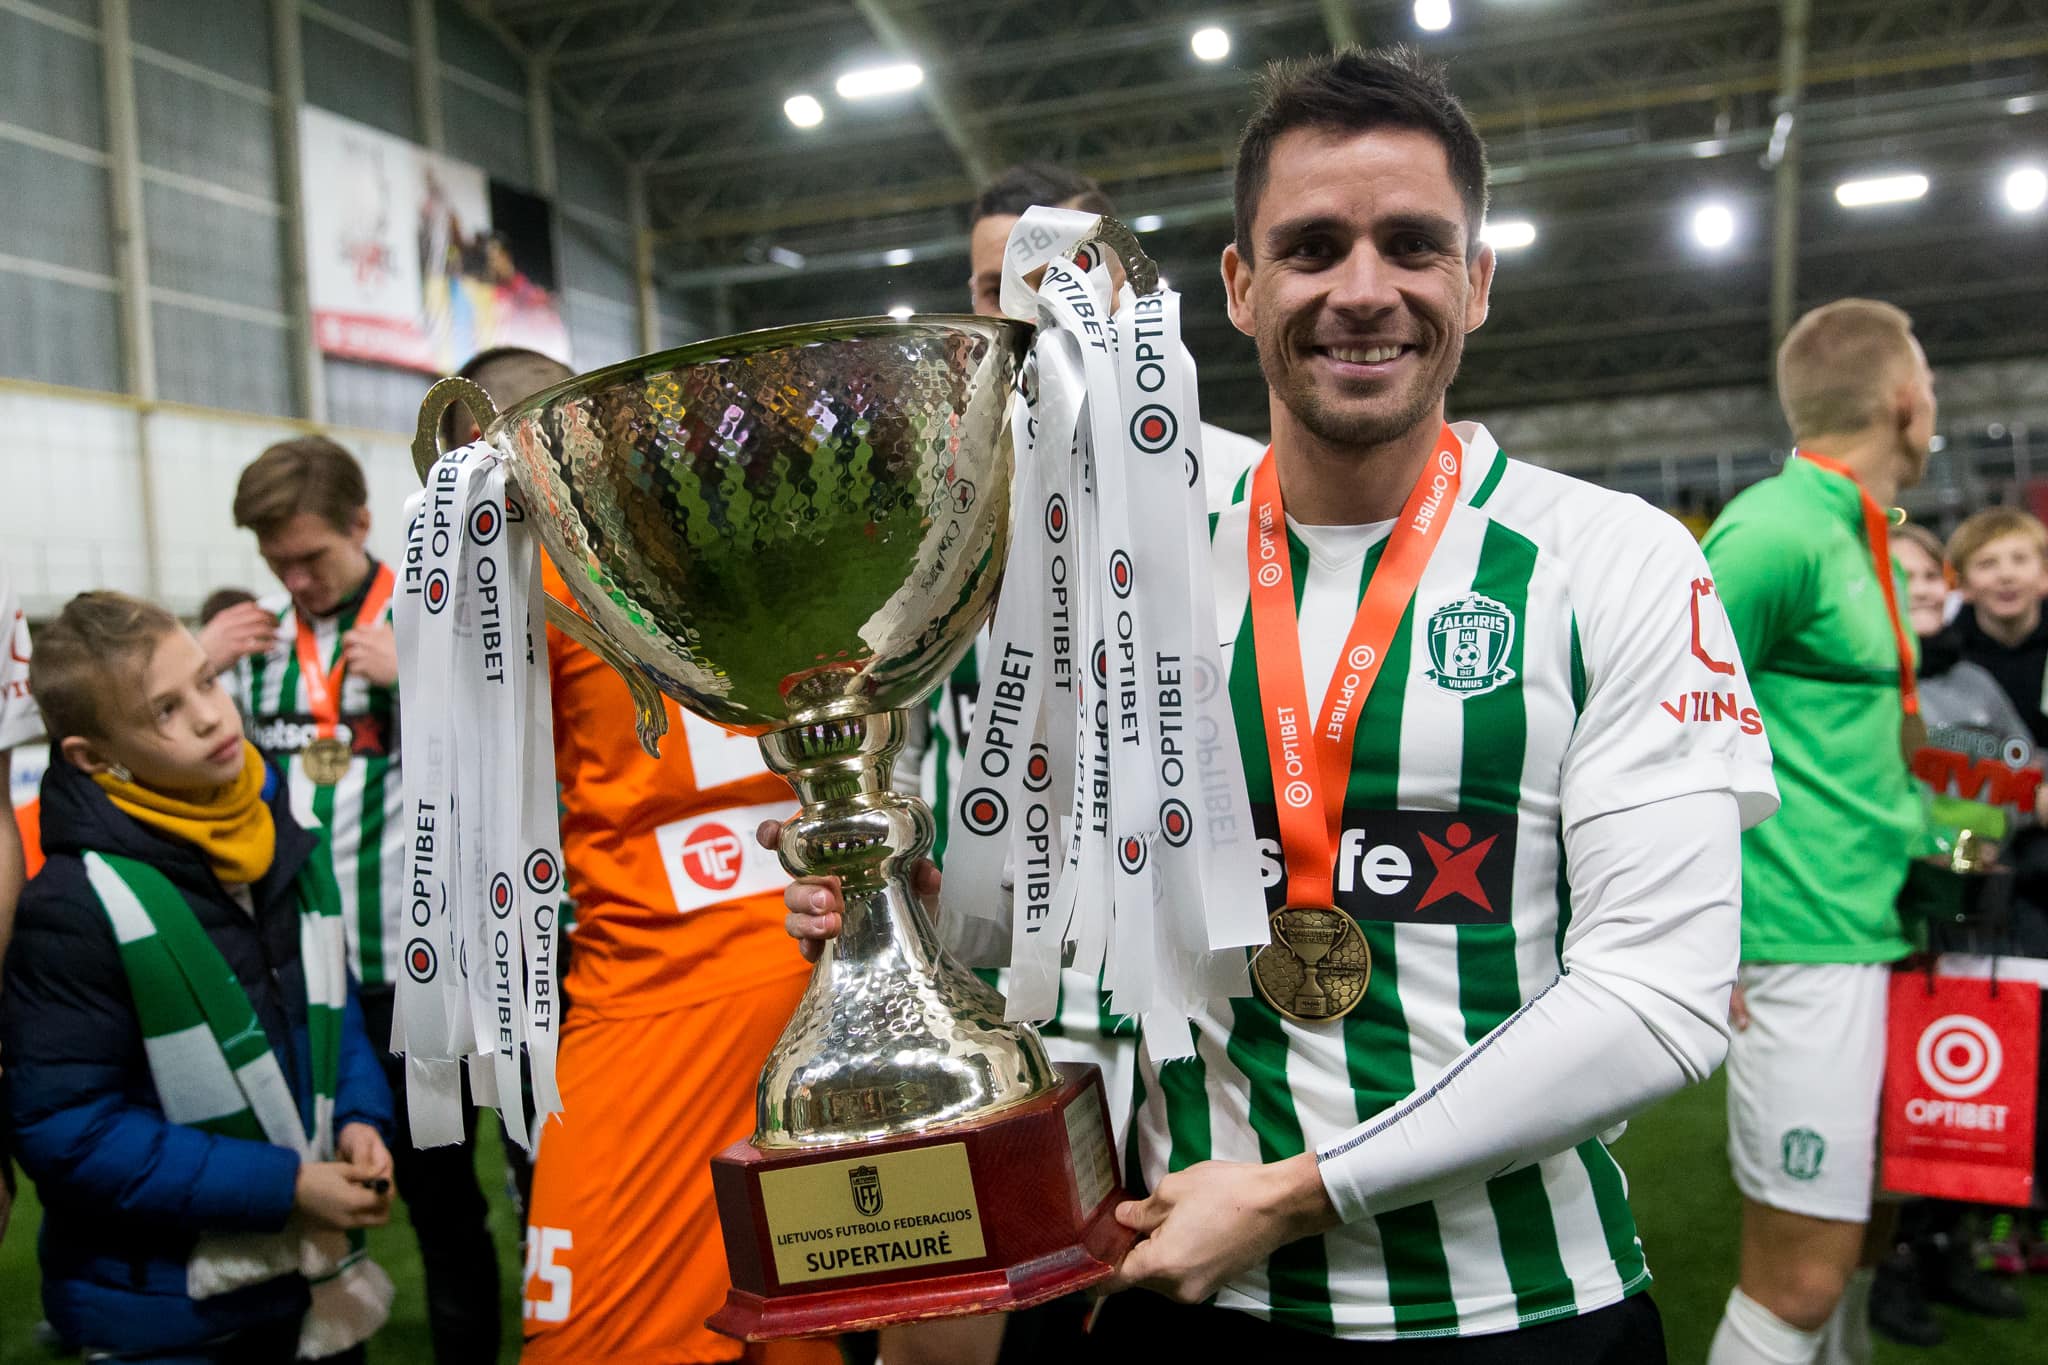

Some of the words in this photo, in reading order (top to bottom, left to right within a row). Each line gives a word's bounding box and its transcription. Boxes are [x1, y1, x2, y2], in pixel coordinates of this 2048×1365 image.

[1135, 291, 1166, 393] OPTIB
[1258, 502, 1275, 560] OPTIBET
[1411, 473, 1449, 536] OPTIBET
[476, 556, 504, 684] OPTIBET
[1051, 555, 1071, 693] OPTIBET
[1433, 615, 1505, 632] ŽALGIRIS
[981, 642, 1034, 777] OPTIBET
[1117, 610, 1140, 746] OPTIBET
[1156, 651, 1184, 787] OPTIBET
[1326, 673, 1360, 742] OPTIBET
[1449, 679, 1483, 688] VILNIUS
[1092, 700, 1109, 838] OPTIBET
[1277, 706, 1303, 777] OPTIBET
[1069, 730, 1085, 872] OPTIBET
[412, 798, 436, 928] OPTIBET
[494, 929, 514, 1062] OPTIBET
[534, 905, 554, 1033] OPTIBET
[1905, 1098, 2009, 1132] OPTIBET
[777, 1228, 834, 1246] LIETUVOS
[835, 1220, 891, 1238] FUTBOLO
[894, 1208, 972, 1230] FEDERACIJOS
[806, 1231, 953, 1273] SUPERTAURĖ
